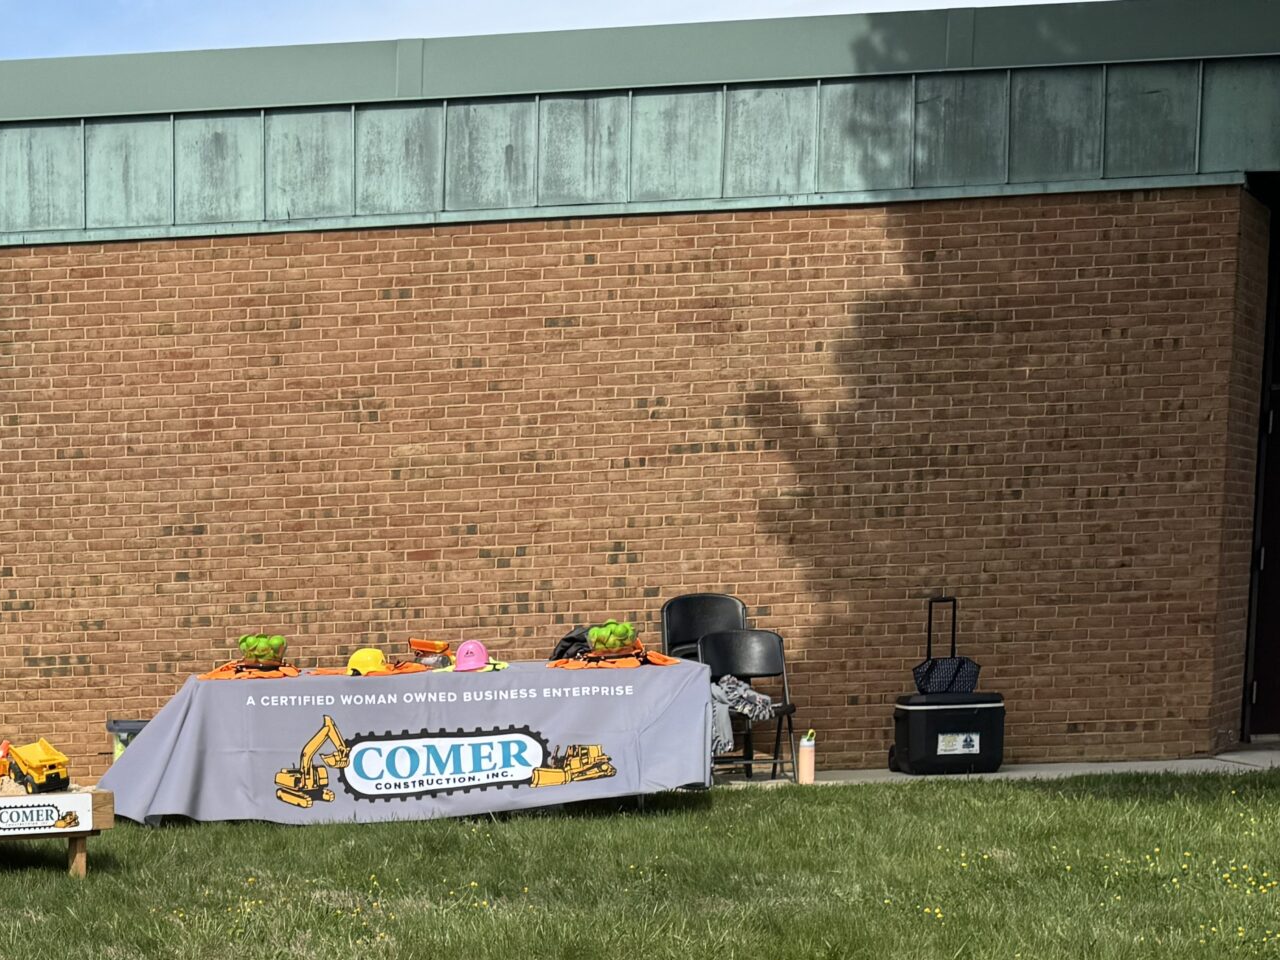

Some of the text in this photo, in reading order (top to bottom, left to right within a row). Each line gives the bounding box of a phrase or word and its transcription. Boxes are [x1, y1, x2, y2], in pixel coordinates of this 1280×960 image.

[246, 685, 634, 707] A CERTIFIED WOMAN OWNED BUSINESS ENTERPRISE
[352, 739, 533, 781] COMER
[486, 770, 514, 780] INC.
